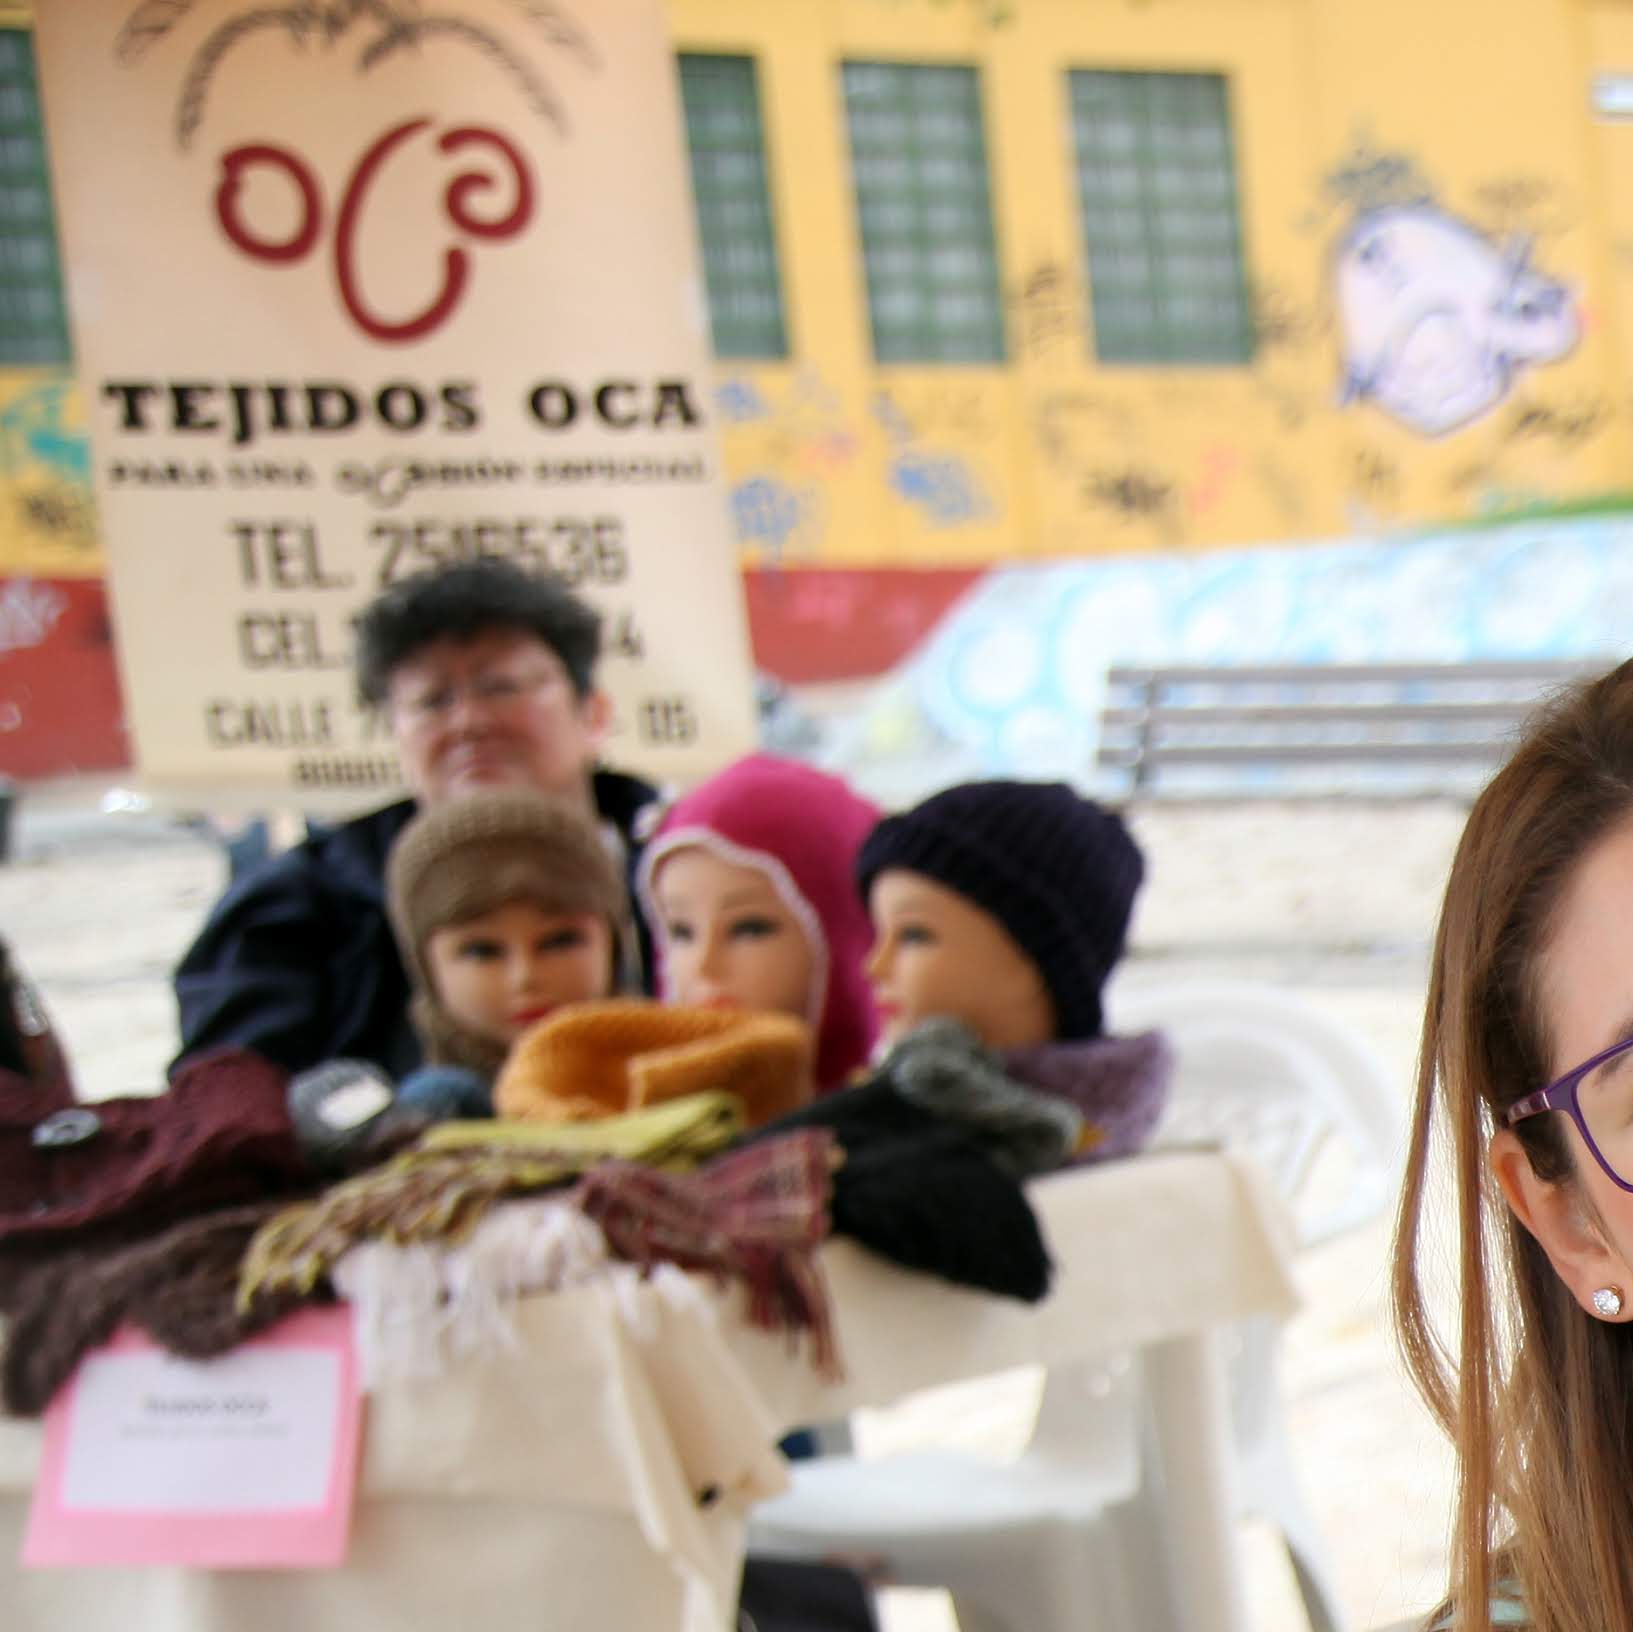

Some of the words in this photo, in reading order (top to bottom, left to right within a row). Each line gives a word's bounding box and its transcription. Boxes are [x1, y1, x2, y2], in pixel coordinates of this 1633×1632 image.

[105, 382, 481, 445] TEJIDOS
[528, 381, 703, 430] OCA
[228, 521, 352, 588] TEL.
